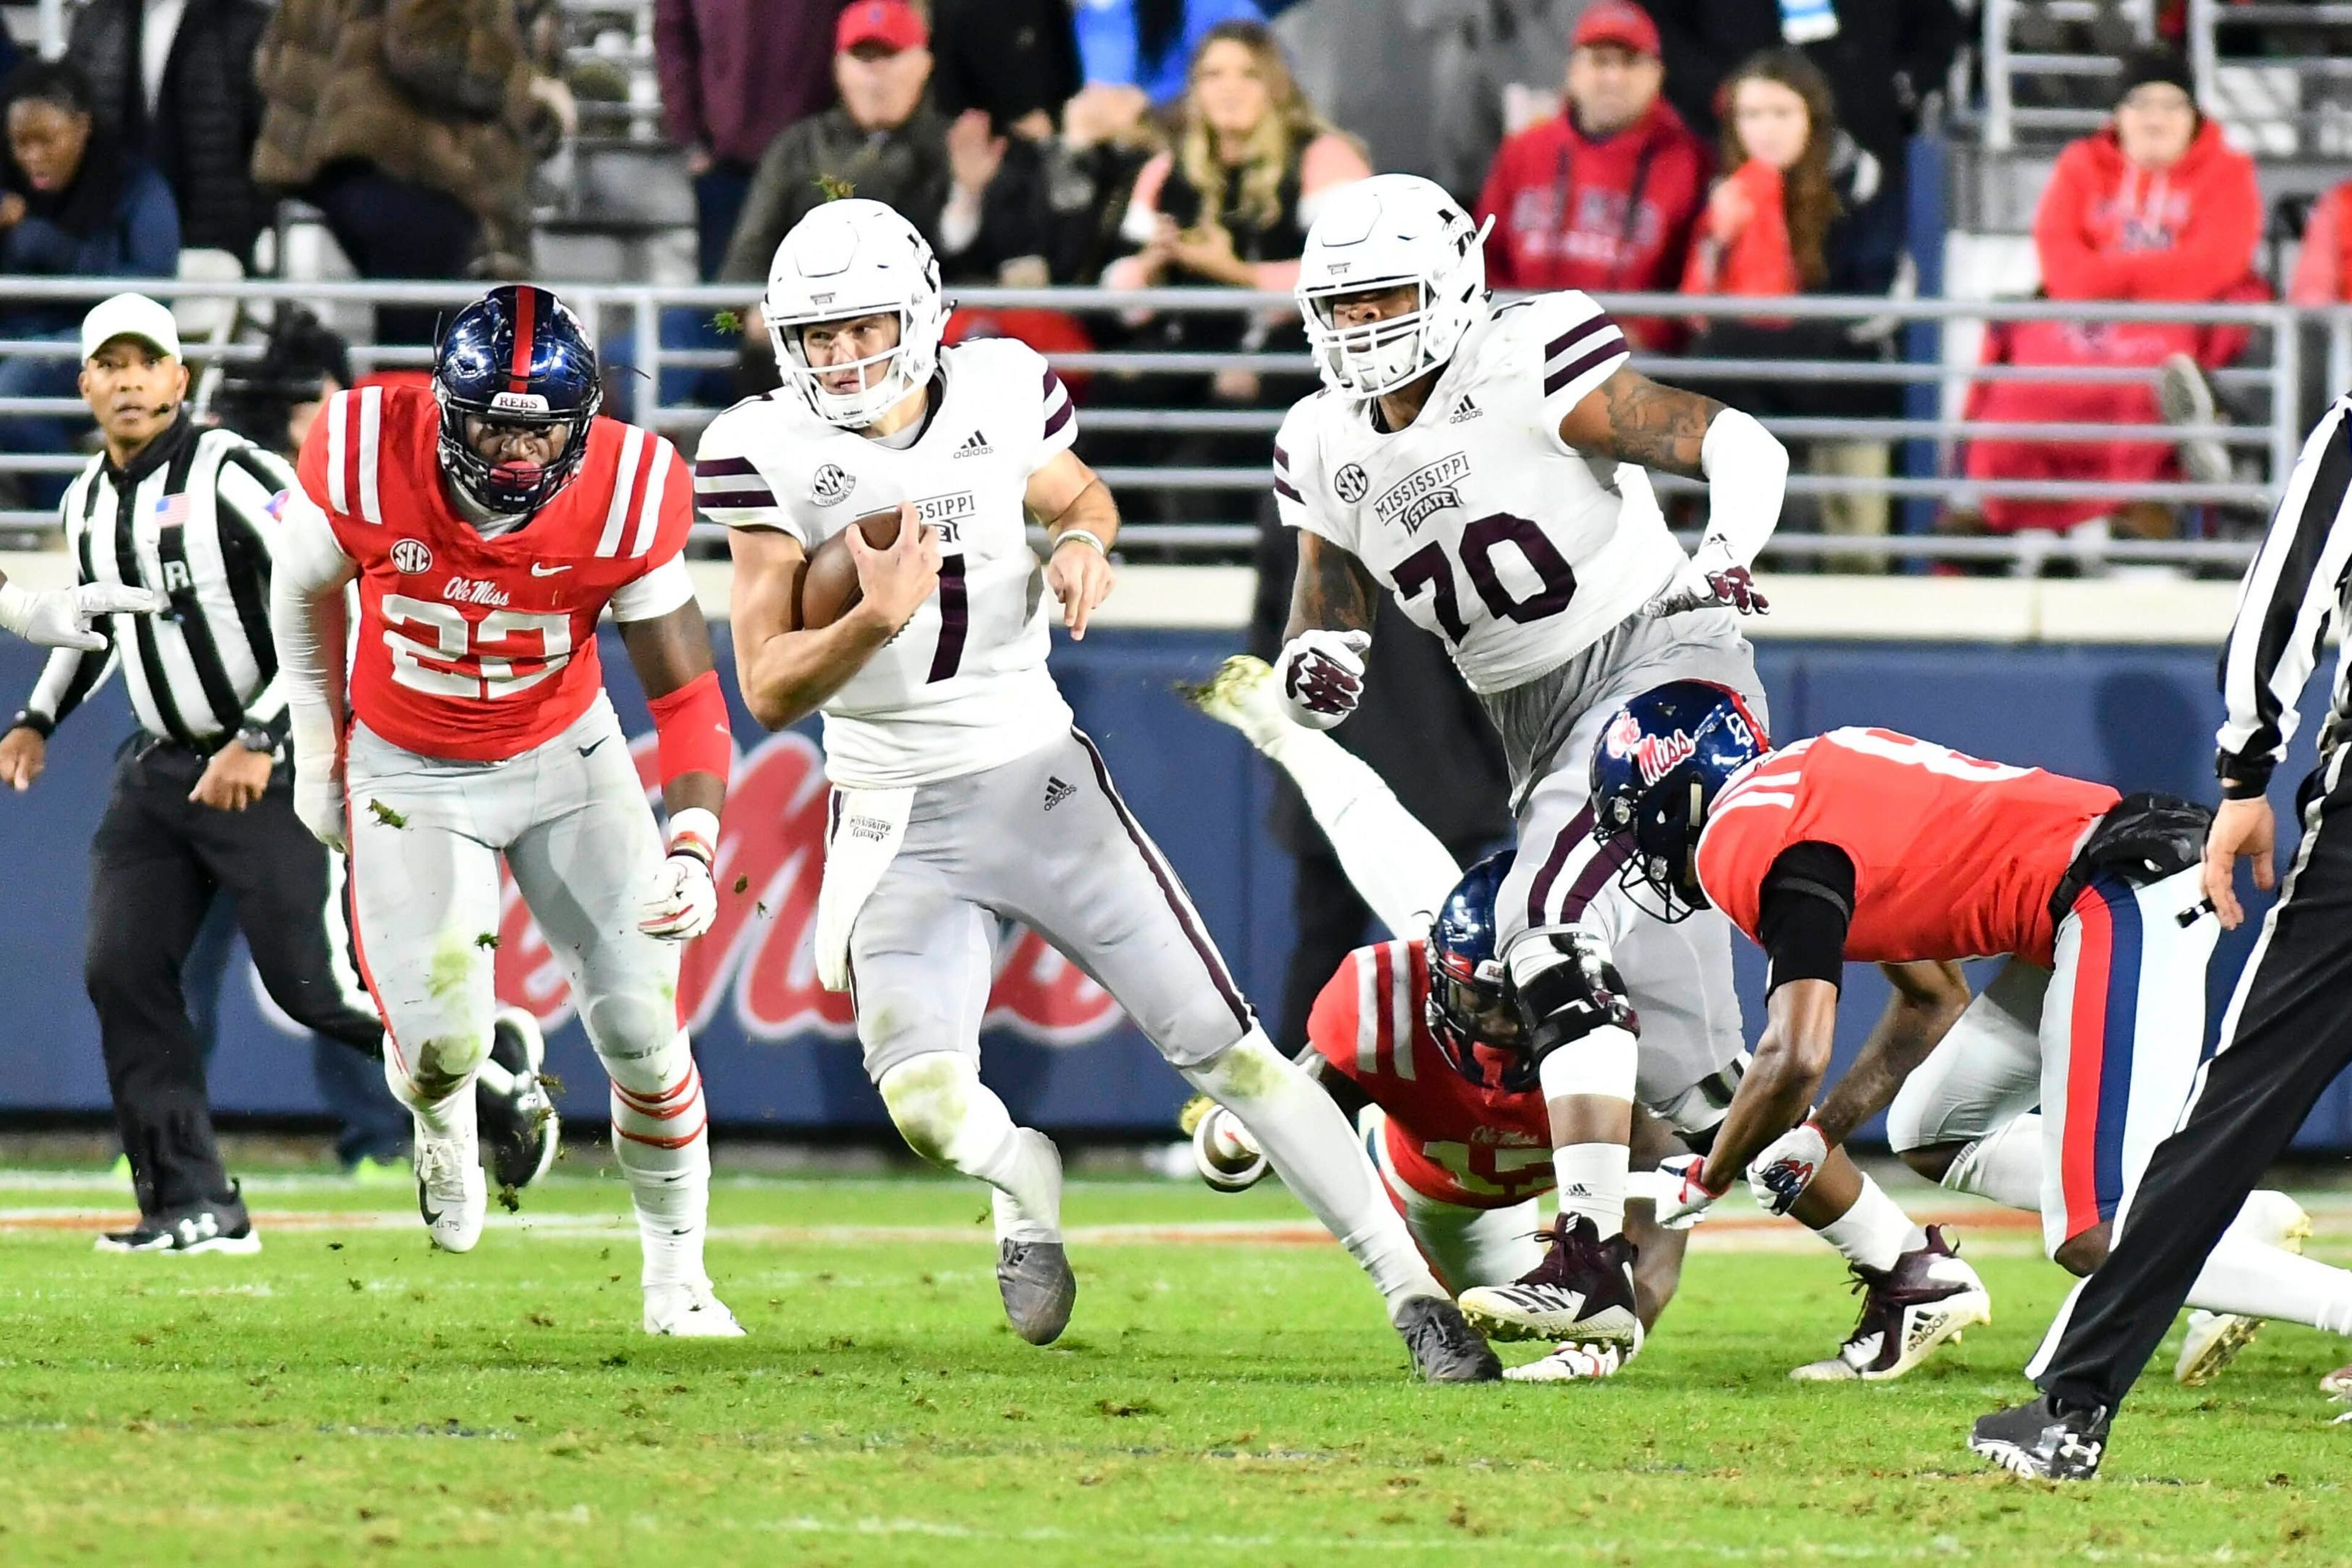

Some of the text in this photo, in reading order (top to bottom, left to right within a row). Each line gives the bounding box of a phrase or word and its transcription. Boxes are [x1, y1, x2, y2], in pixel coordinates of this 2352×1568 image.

[499, 397, 538, 409] REBS
[1450, 408, 1483, 424] adidas
[953, 446, 993, 459] adidas
[815, 465, 845, 496] SEC
[1335, 465, 1366, 502] SEC
[1375, 455, 1469, 522] MISSISSIPPI
[916, 495, 975, 521] SSIPPI
[1410, 494, 1455, 526] STATE
[394, 541, 429, 572] SEC
[164, 560, 191, 592] R
[443, 576, 510, 606] Ole Miss
[1390, 511, 1577, 647] 70
[382, 594, 571, 700] 23
[1637, 729, 1696, 786] Miss
[1044, 784, 1077, 812] adidas
[1907, 1312, 1949, 1352] adidas
